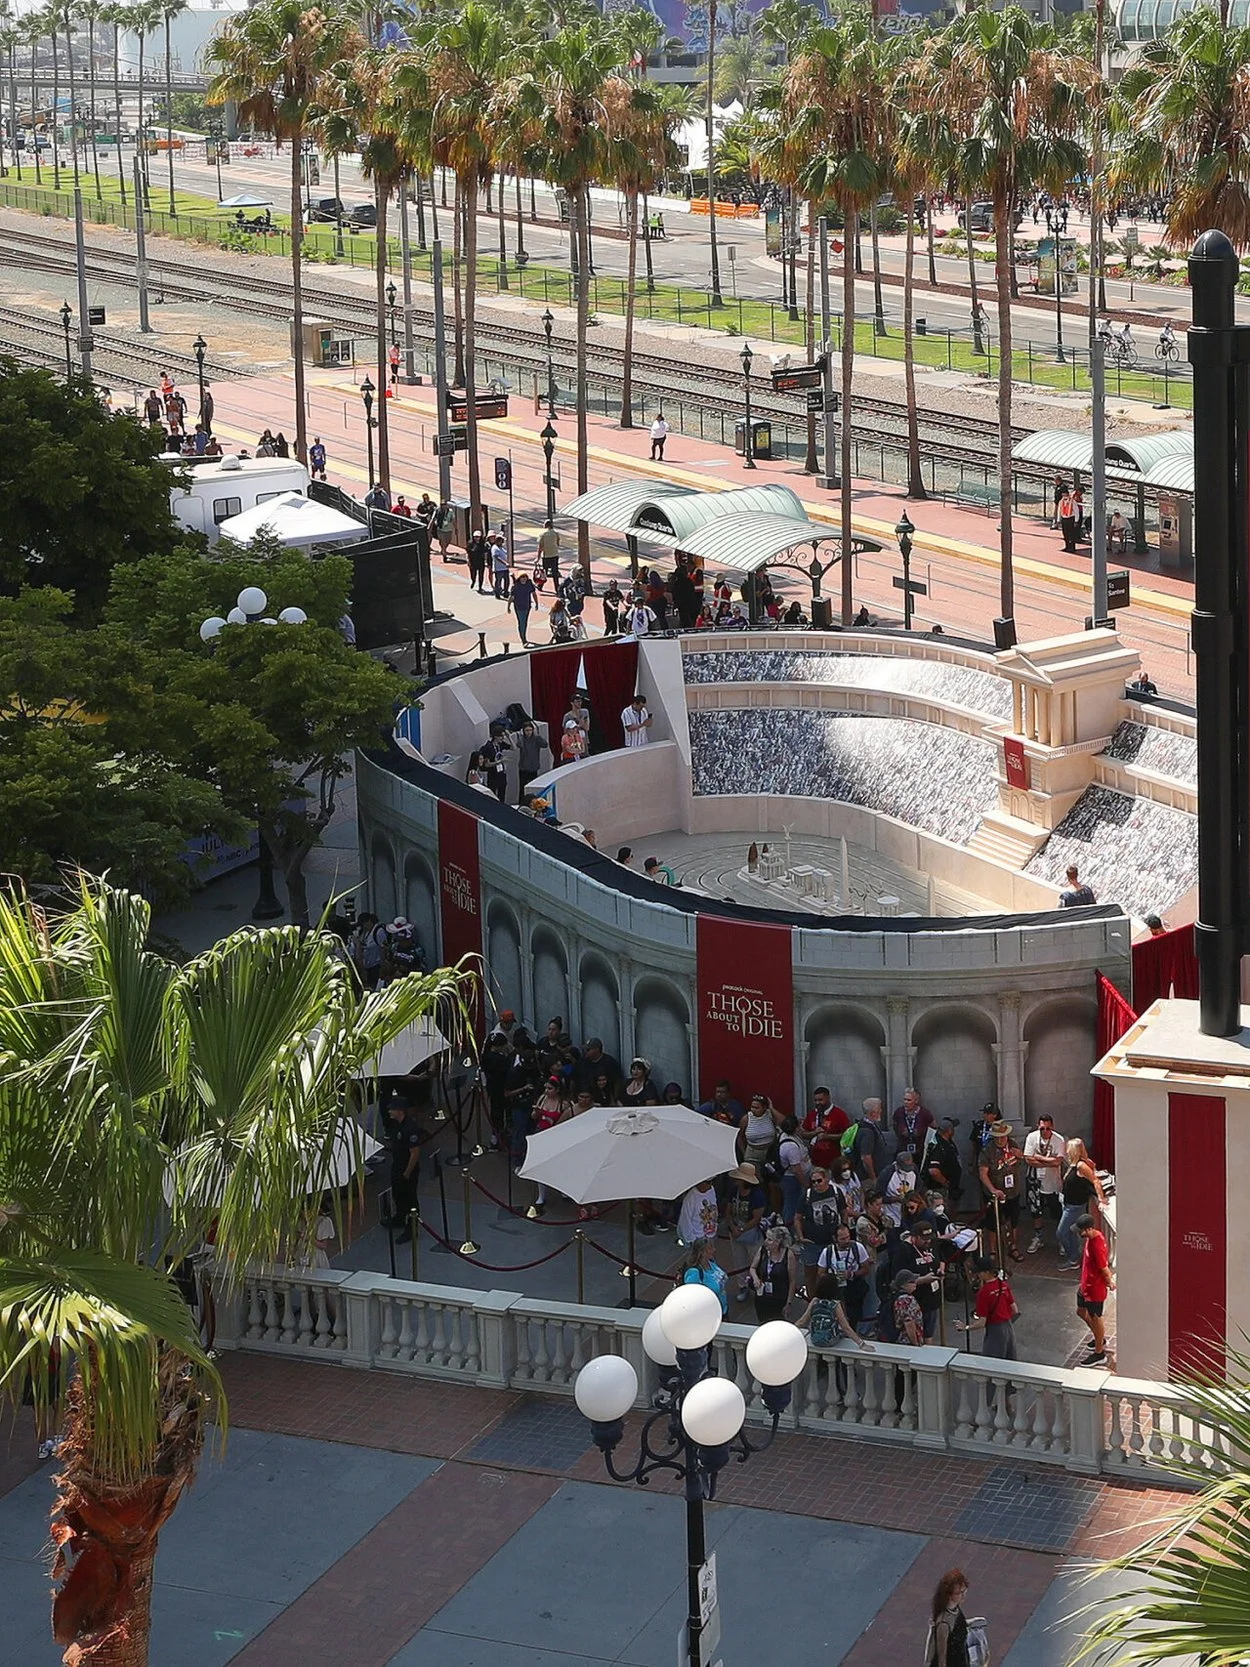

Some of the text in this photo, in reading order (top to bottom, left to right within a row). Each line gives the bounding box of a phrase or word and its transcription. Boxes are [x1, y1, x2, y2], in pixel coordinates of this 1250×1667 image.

[443, 866, 472, 896] THOSE
[460, 892, 477, 915] DIE
[707, 991, 775, 1018] THOSE
[706, 1010, 740, 1024] ABOUT
[726, 1016, 784, 1039] TO DIE
